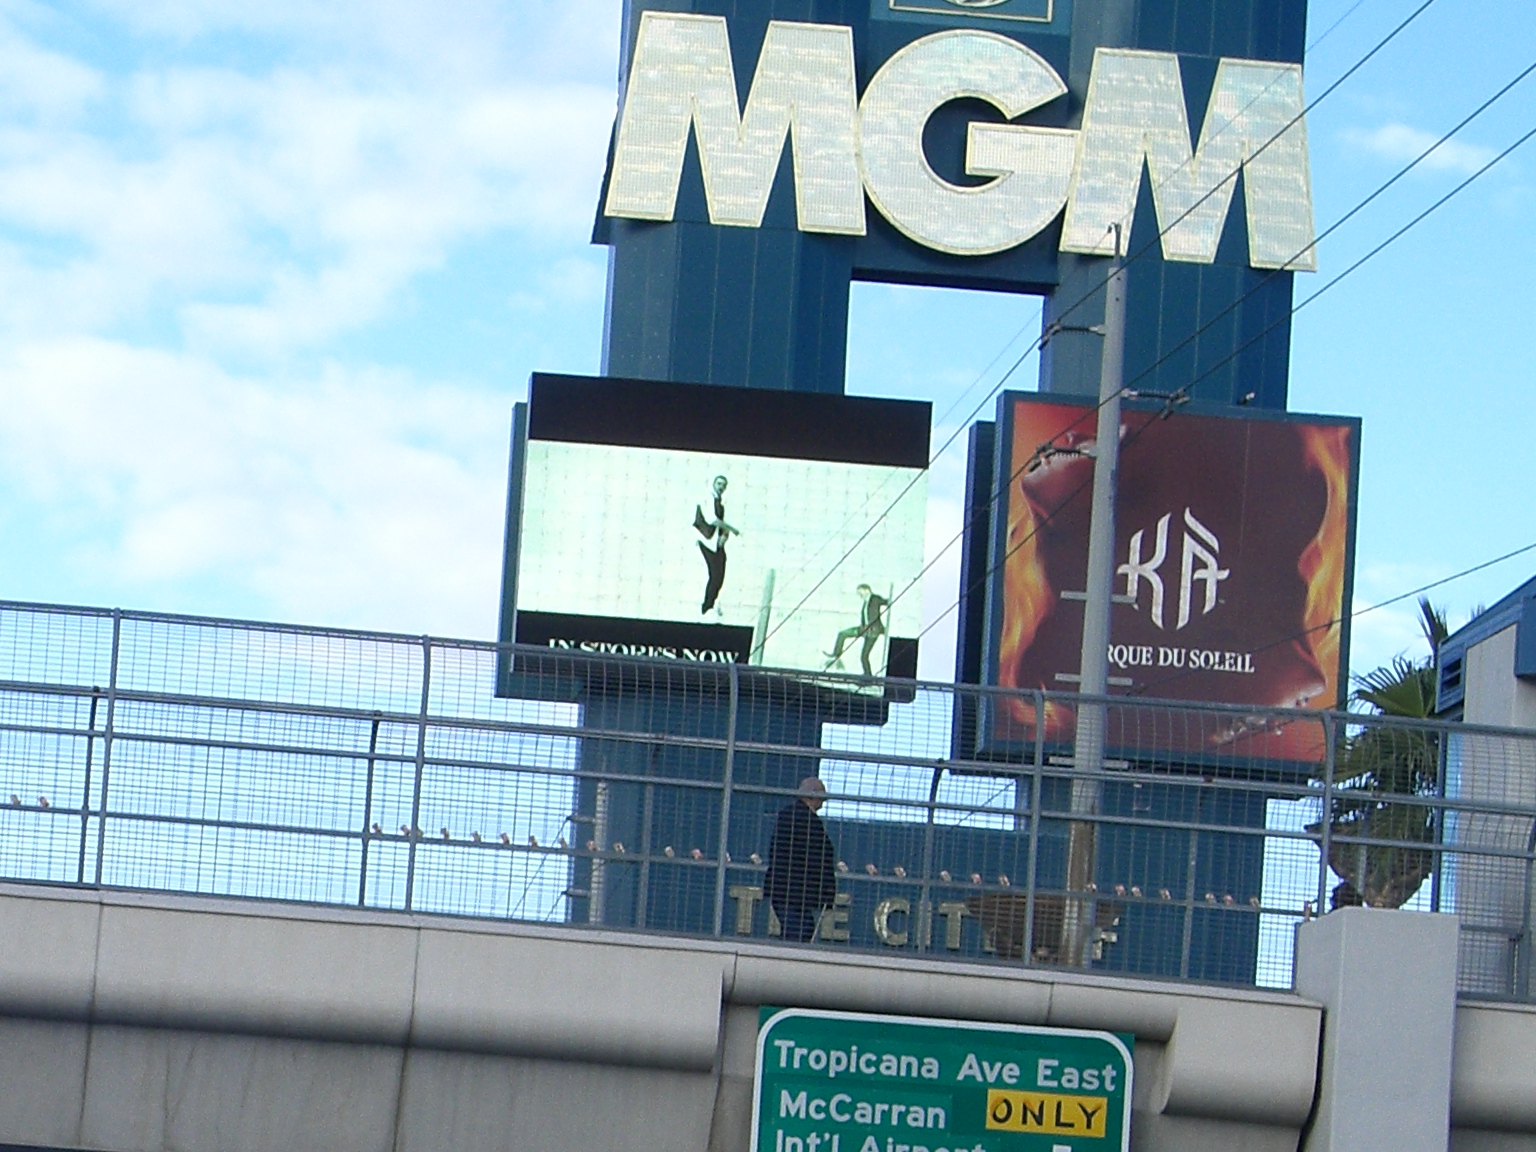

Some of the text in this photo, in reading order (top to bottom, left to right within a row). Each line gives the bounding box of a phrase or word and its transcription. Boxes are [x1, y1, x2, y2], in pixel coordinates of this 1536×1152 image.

[604, 11, 1317, 272] MGM
[548, 638, 574, 649] IN
[683, 648, 739, 664] NOW
[1158, 647, 1187, 668] DU
[1189, 649, 1255, 673] SOLEIL
[729, 886, 852, 941] TE
[773, 1039, 1116, 1092] Tropicana Ave East
[778, 1090, 946, 1129] McCarran
[991, 1098, 1102, 1130] ONLY
